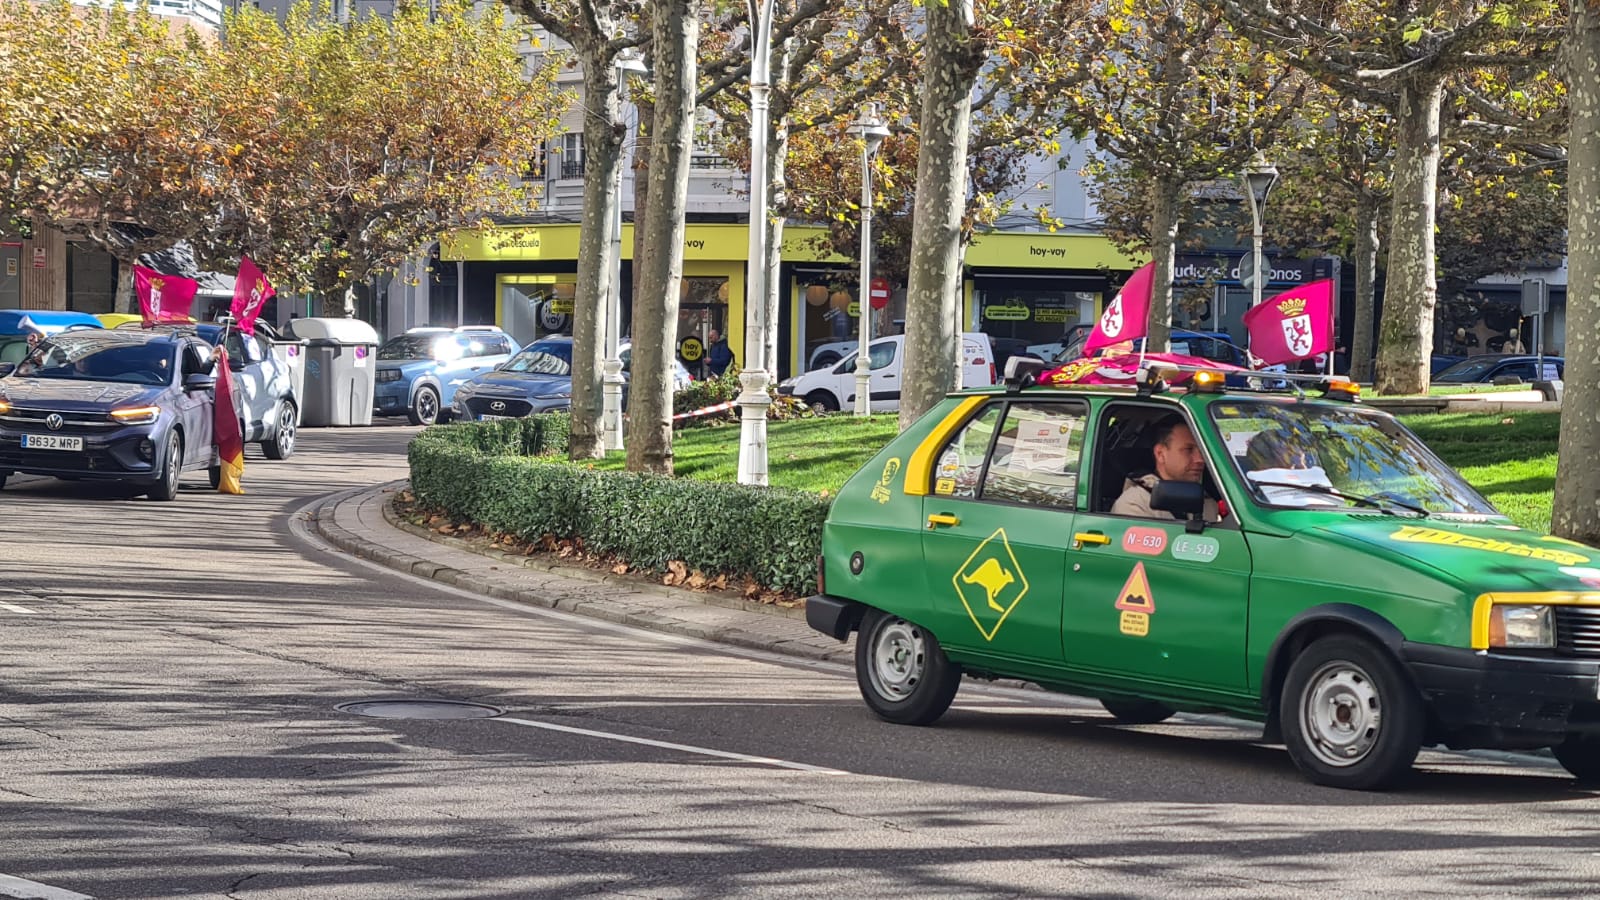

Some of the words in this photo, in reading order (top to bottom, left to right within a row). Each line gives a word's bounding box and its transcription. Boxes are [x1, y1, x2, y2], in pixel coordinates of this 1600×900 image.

[1030, 245, 1066, 258] hoy-voy
[28, 436, 57, 448] 9632
[59, 438, 80, 449] MRP
